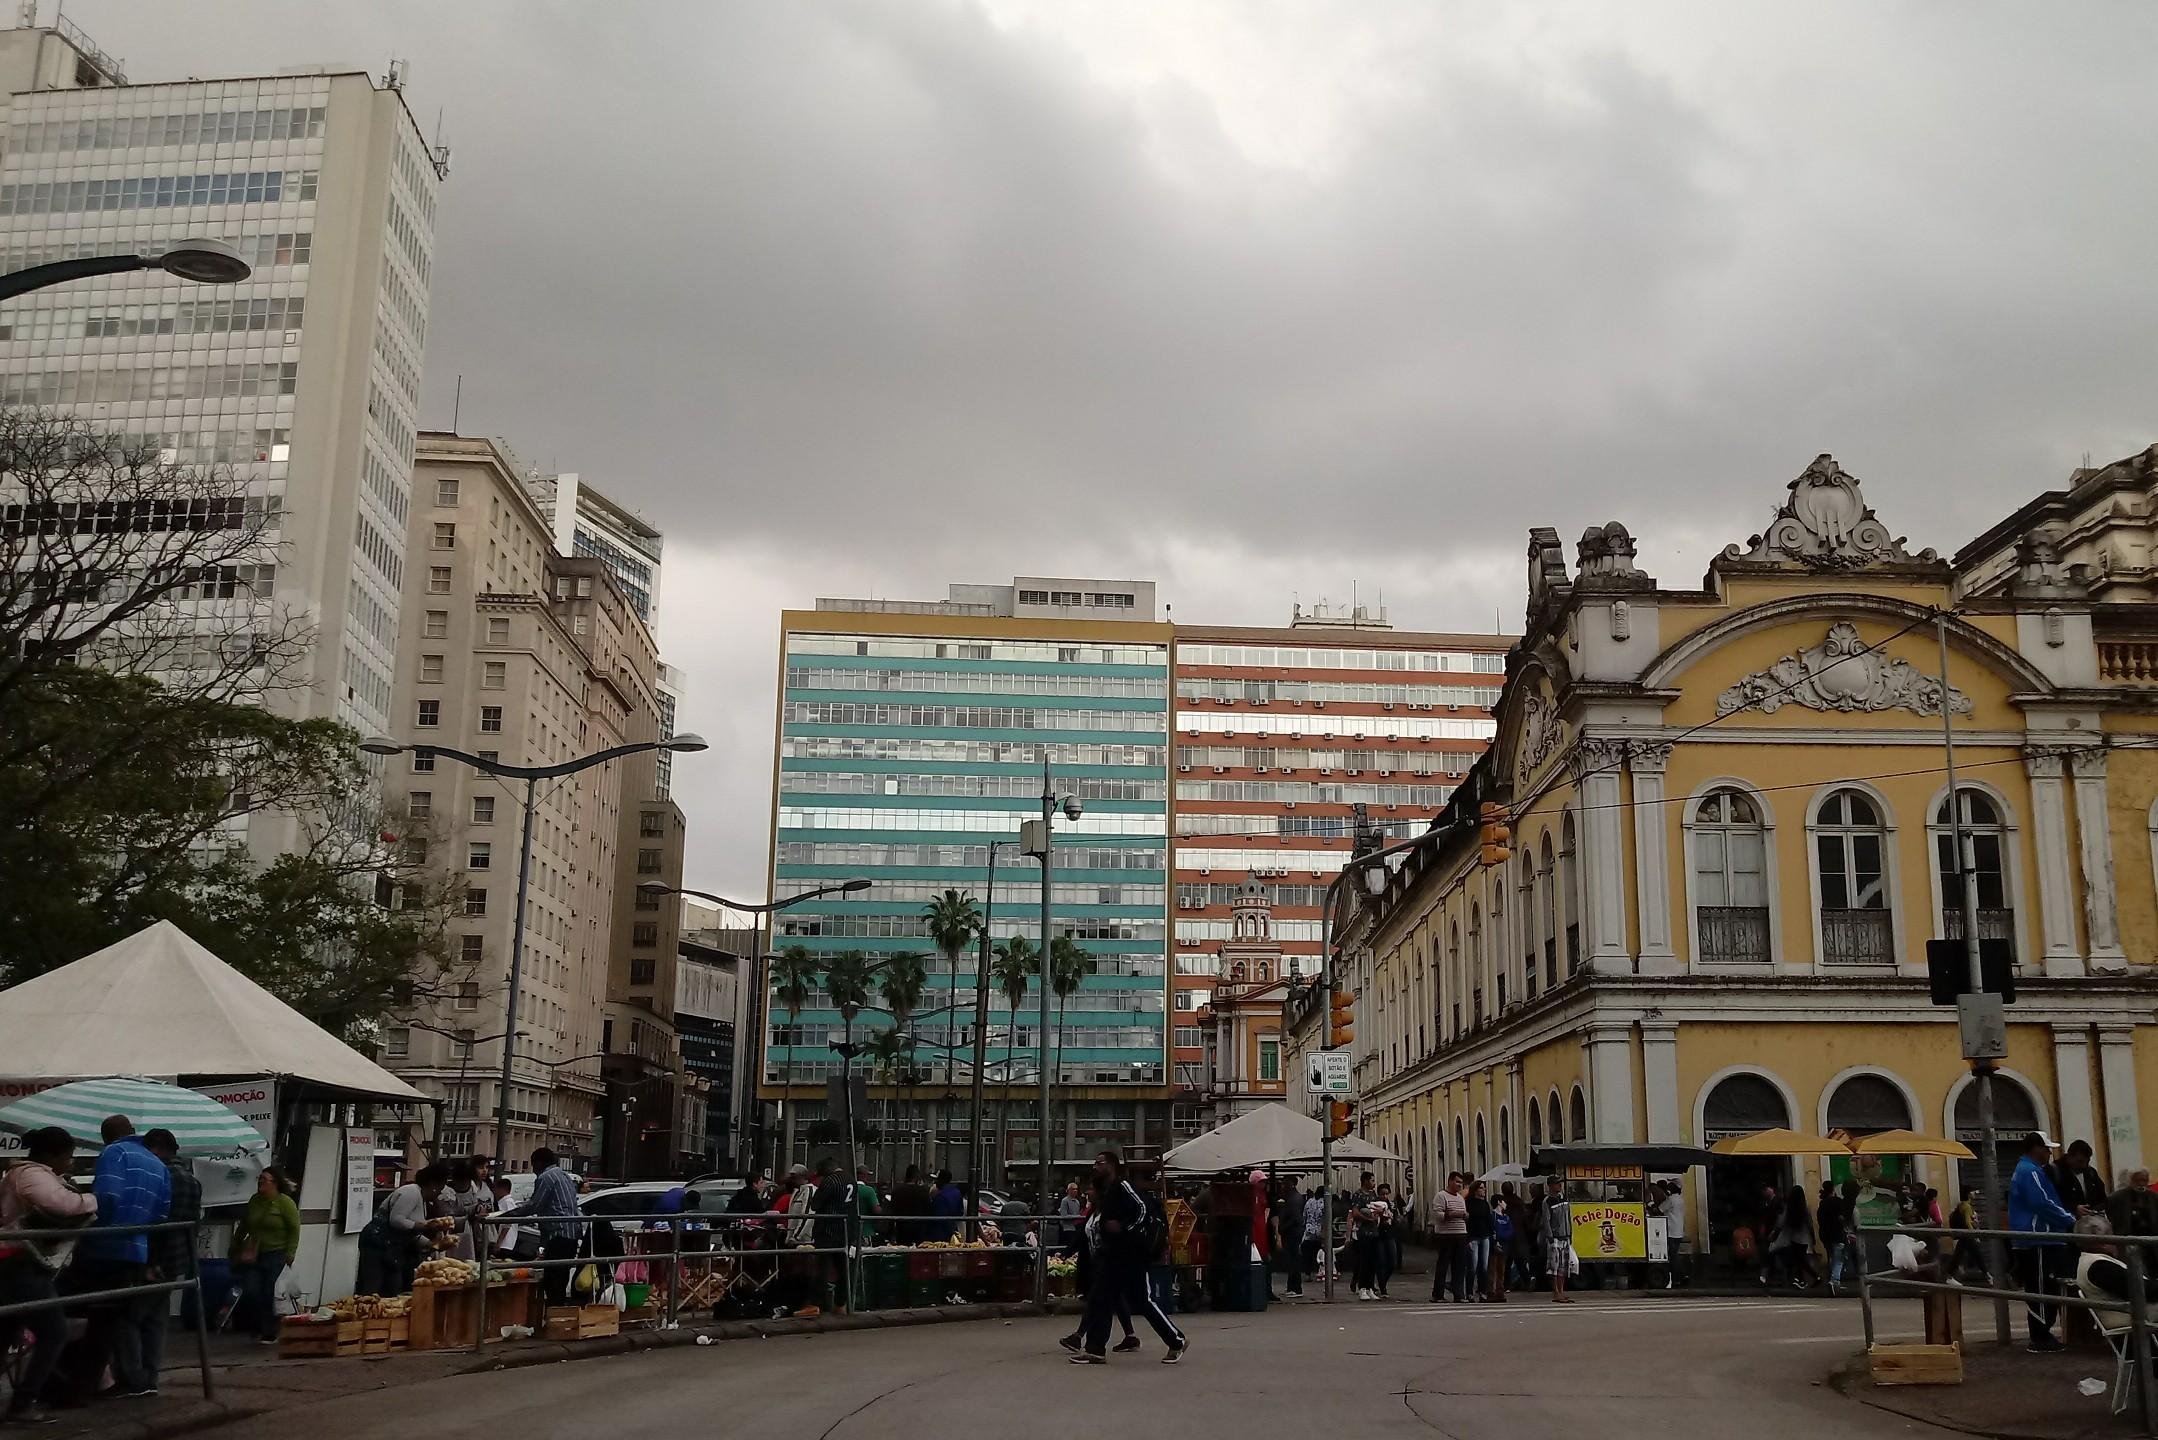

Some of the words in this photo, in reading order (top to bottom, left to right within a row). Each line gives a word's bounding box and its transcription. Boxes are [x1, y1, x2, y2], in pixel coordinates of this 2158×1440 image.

[251, 1112, 272, 1121] PEIXE
[844, 1183, 854, 1203] 2
[1573, 1209, 1602, 1227] Tchê
[1605, 1208, 1641, 1227] Dogão
